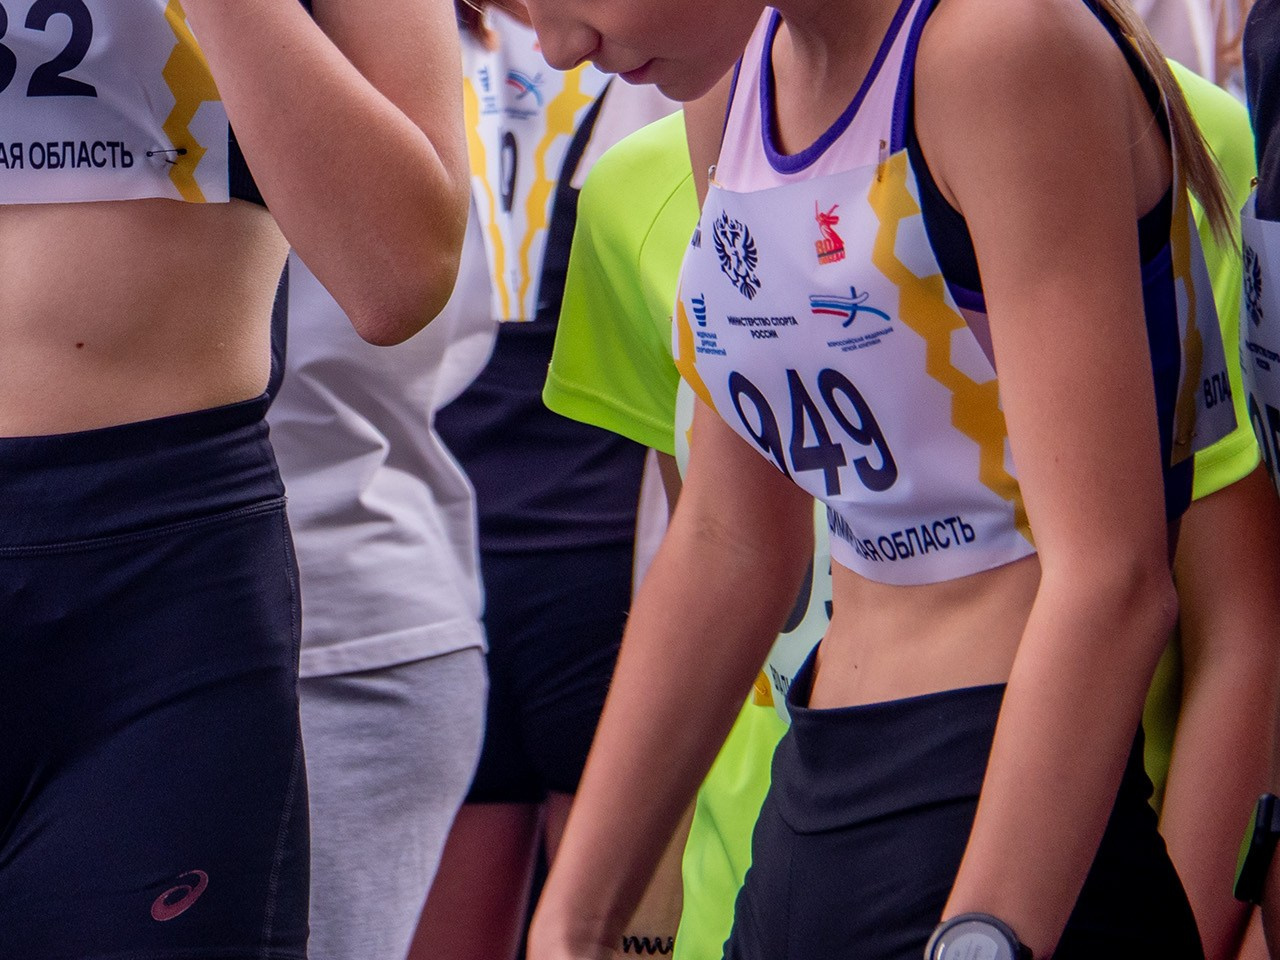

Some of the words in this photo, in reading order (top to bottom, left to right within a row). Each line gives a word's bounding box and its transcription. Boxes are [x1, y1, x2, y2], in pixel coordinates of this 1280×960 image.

[28, 141, 134, 169] ОБЛАСТЬ
[728, 368, 898, 496] 949
[877, 516, 976, 561] ОБЛАСТЬ
